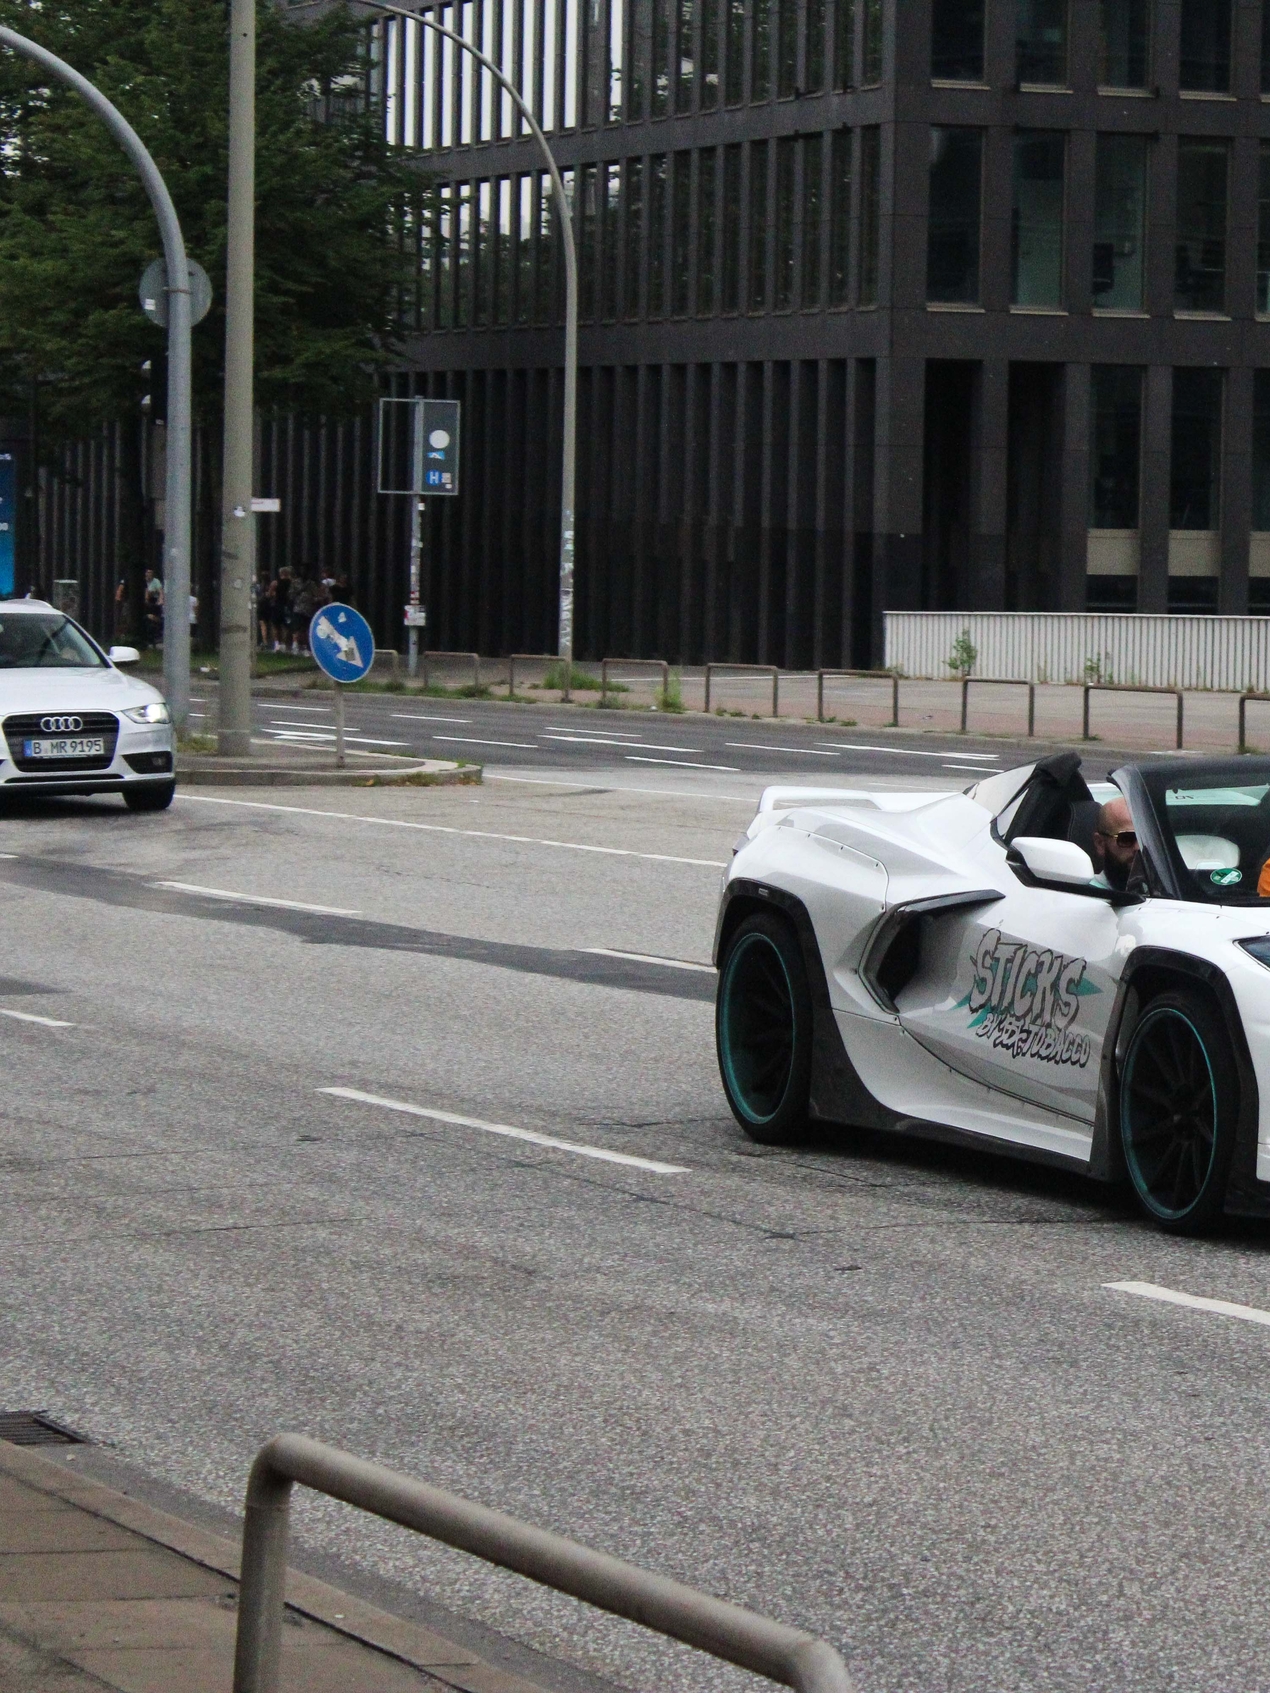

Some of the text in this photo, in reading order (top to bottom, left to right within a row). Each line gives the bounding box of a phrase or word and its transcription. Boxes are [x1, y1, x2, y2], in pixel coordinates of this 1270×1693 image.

[33, 740, 102, 754] B MR 9195
[969, 928, 1087, 1032] STICKS
